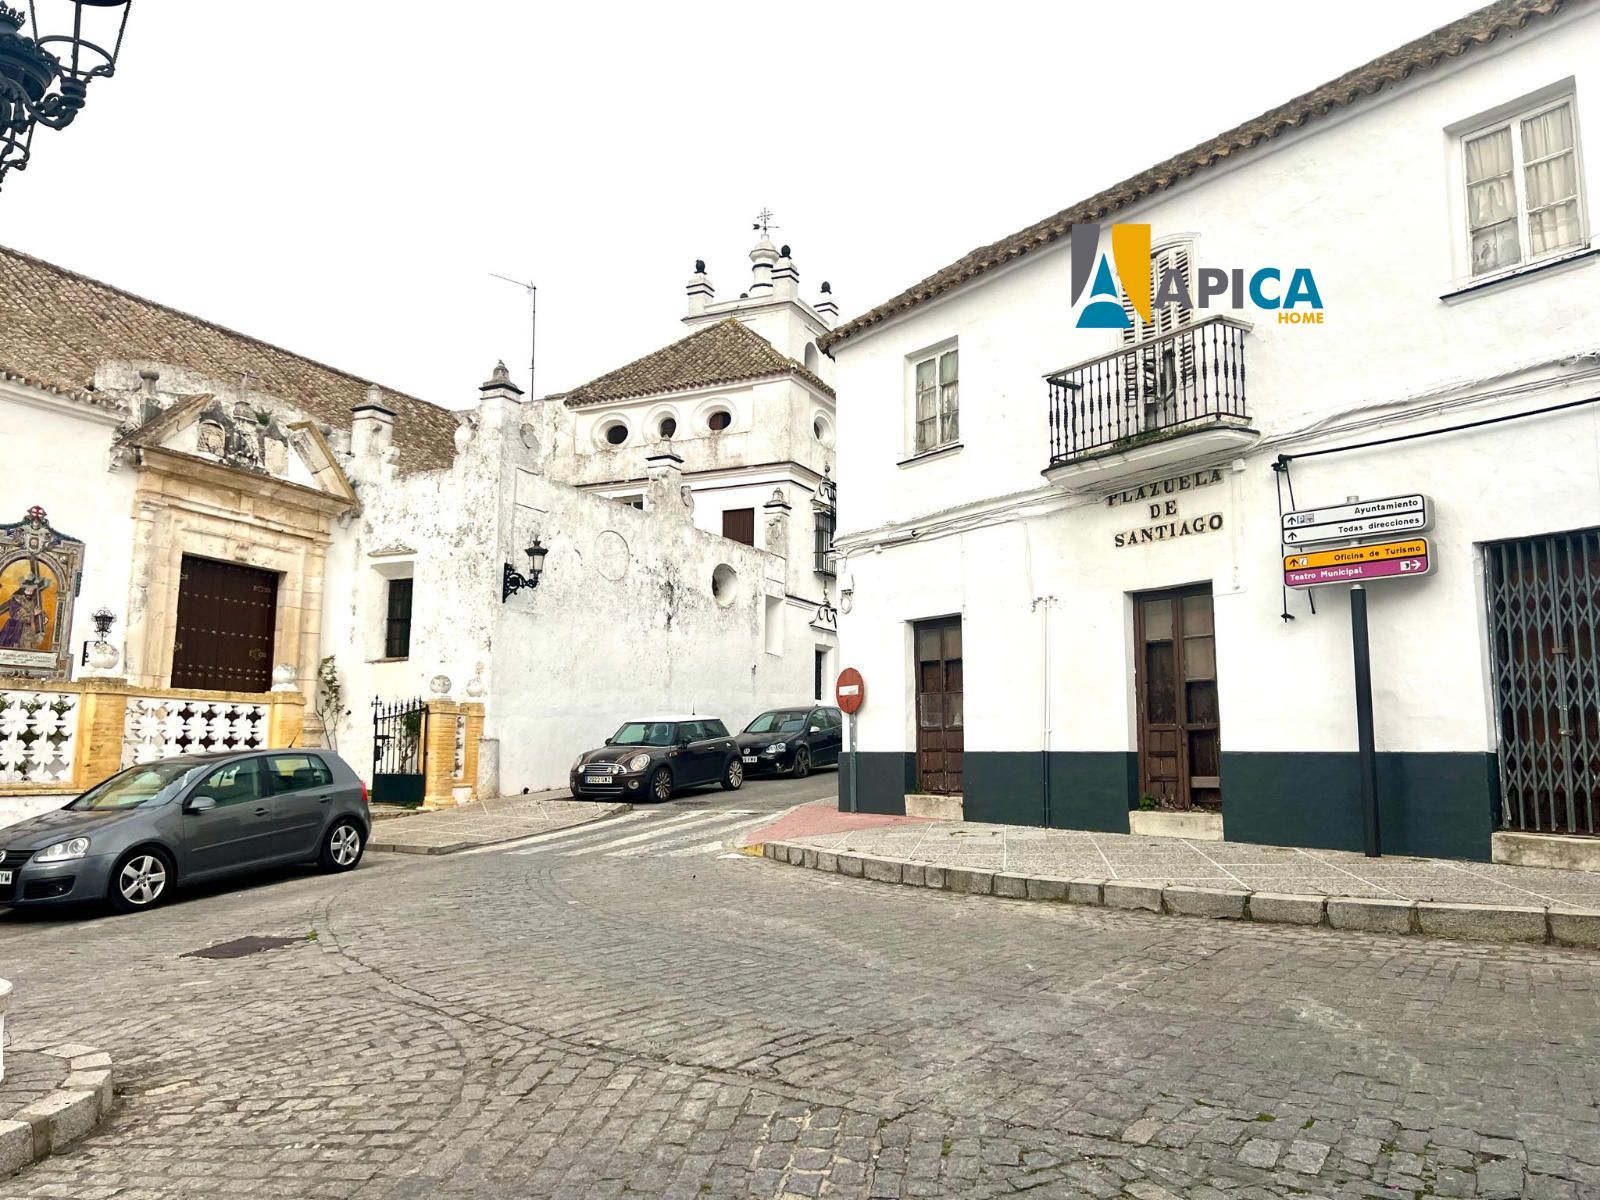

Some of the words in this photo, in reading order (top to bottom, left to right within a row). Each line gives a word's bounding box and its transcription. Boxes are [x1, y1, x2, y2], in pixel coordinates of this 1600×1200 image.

[1107, 469, 1222, 506] PLAZUELA
[1149, 500, 1177, 519] DE
[1354, 499, 1419, 515] Ayuntamiento
[1114, 514, 1223, 548] SANTIAGO
[1338, 524, 1363, 534] Todas
[1368, 517, 1420, 530] direcciones
[1334, 552, 1364, 561] Oficina
[1369, 550, 1380, 558] de
[1385, 545, 1421, 555] Turismo
[1290, 570, 1316, 581] Teatro
[1320, 567, 1363, 578] Municipal
